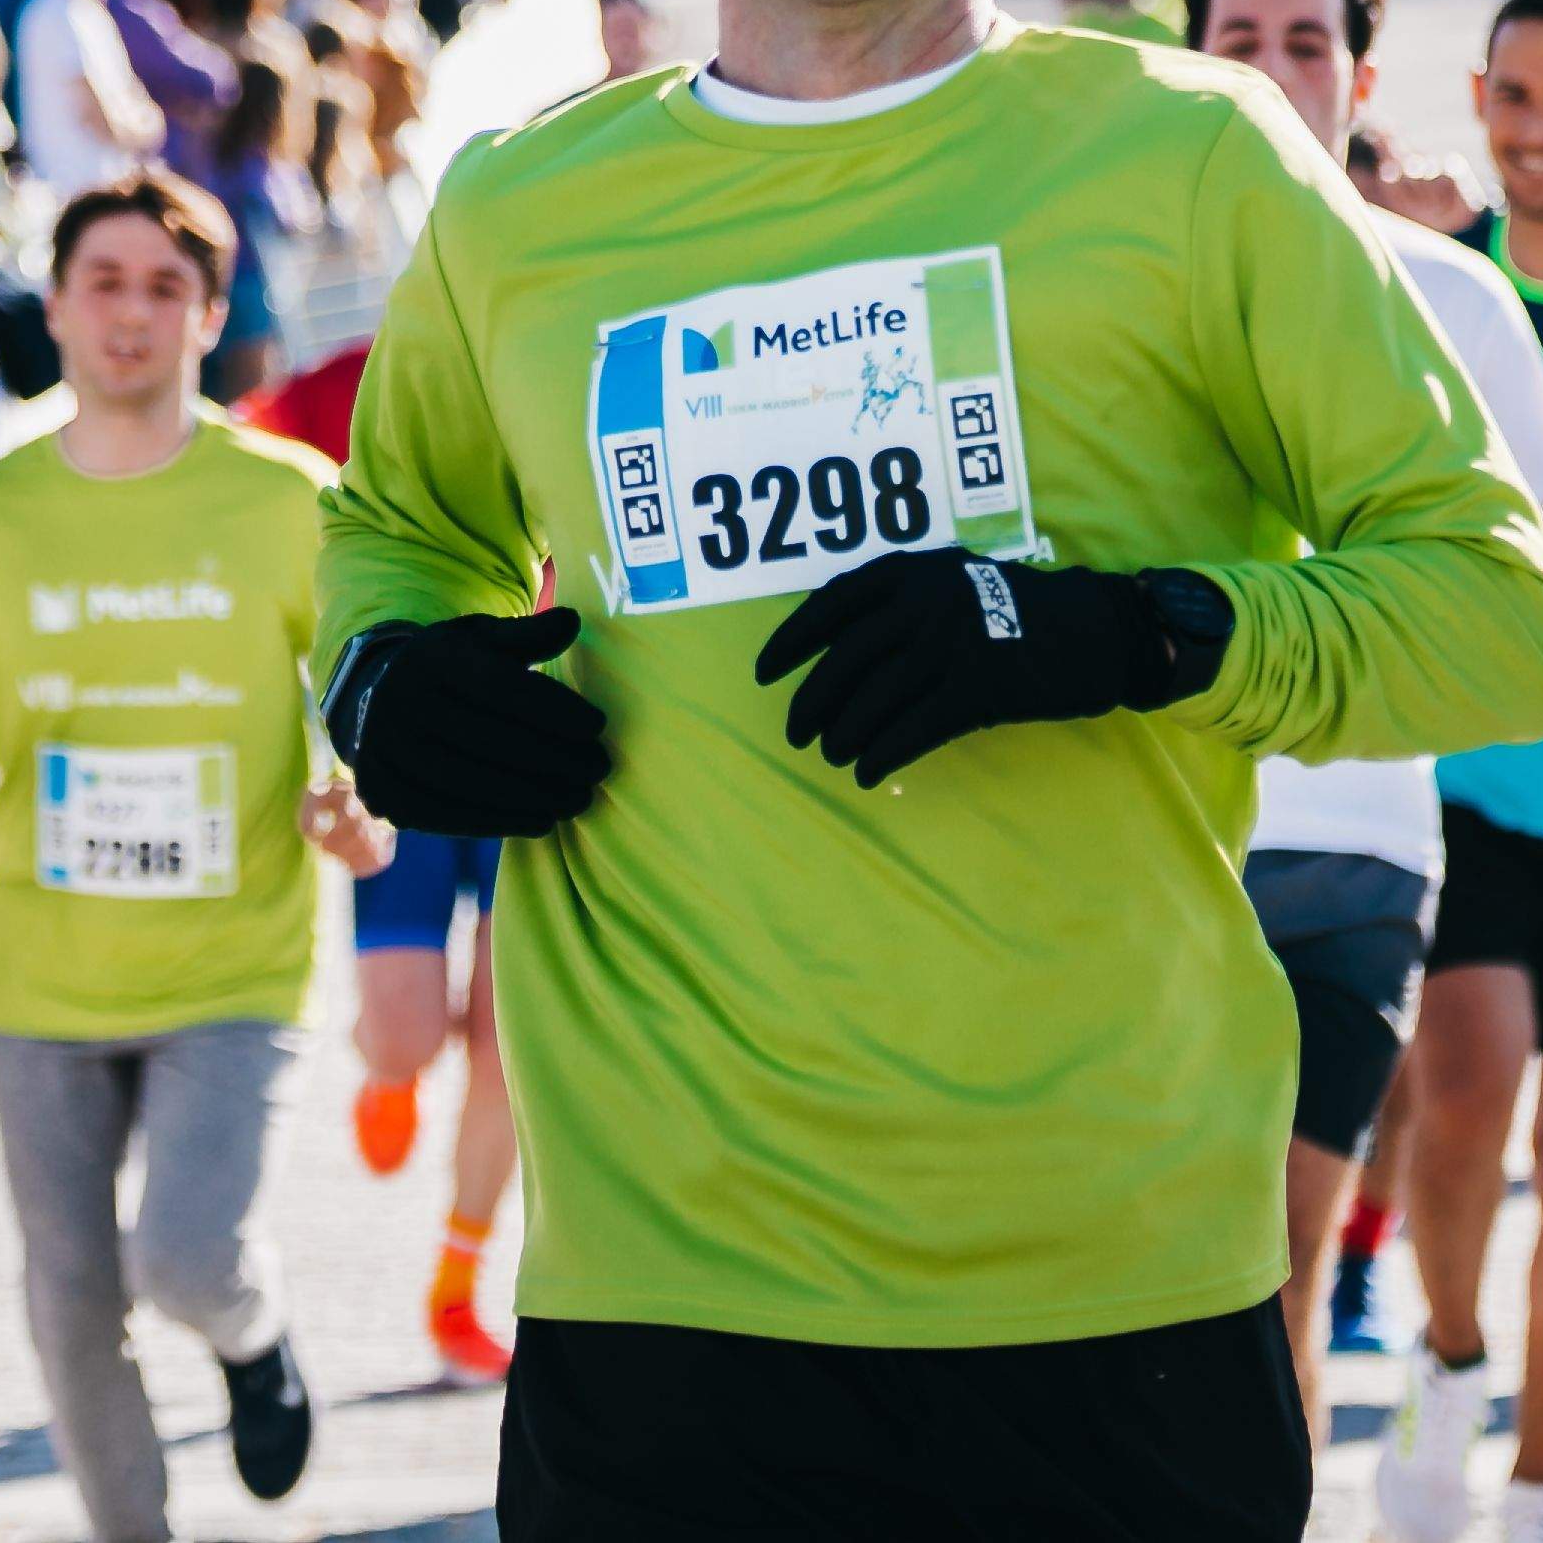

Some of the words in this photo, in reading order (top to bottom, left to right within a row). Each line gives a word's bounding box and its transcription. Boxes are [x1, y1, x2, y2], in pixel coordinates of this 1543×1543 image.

[752, 300, 908, 359] MetLife
[684, 393, 724, 420] VIII
[691, 446, 931, 571] 3298
